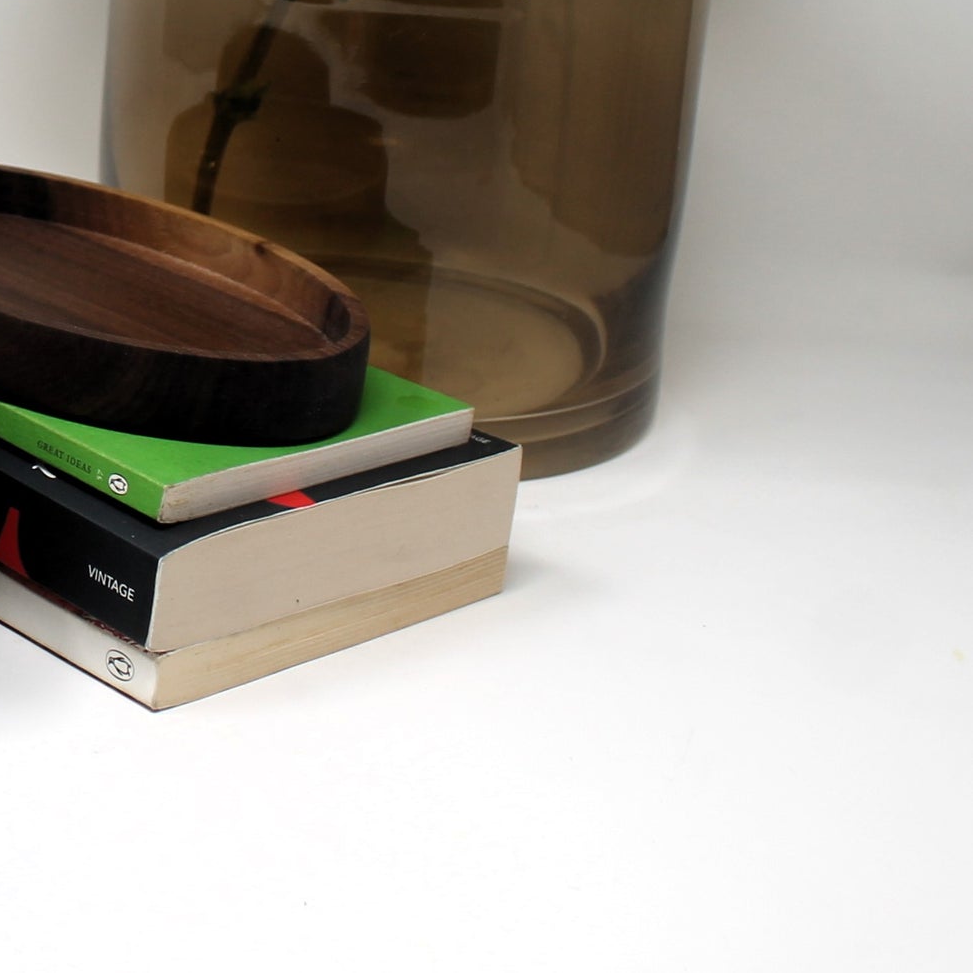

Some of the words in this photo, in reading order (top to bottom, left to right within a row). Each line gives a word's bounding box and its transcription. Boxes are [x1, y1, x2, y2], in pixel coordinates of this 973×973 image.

[37, 439, 64, 459] GREAT
[67, 454, 92, 474] IDEAS
[88, 564, 135, 602] VINTAGE
